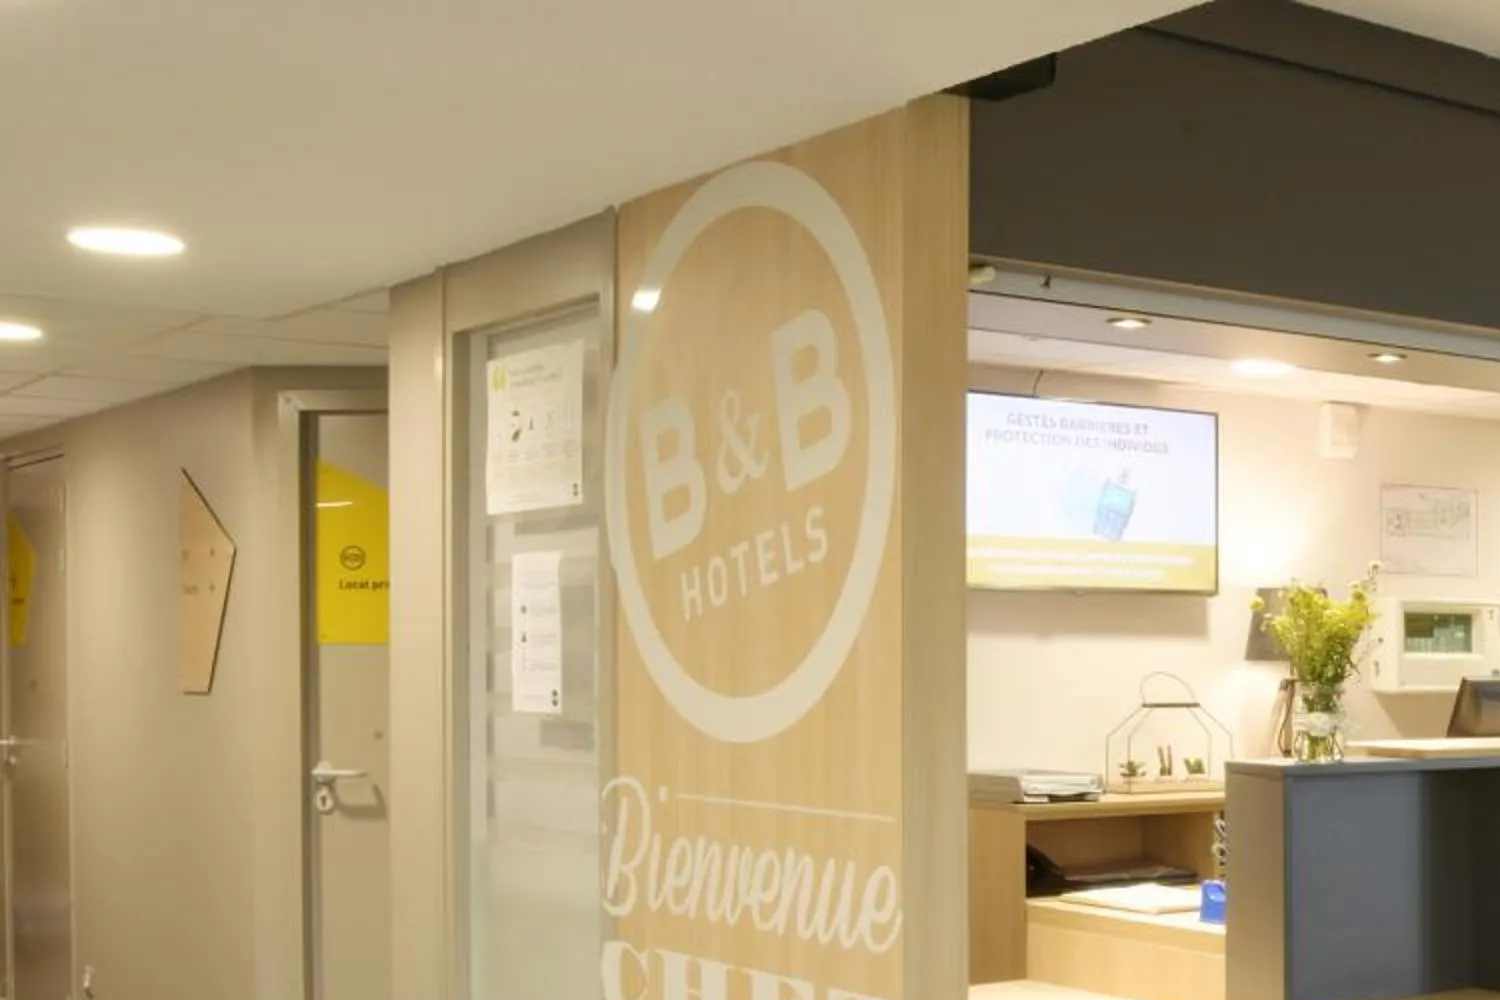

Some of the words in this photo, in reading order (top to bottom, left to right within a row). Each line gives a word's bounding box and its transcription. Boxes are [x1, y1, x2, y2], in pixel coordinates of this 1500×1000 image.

[639, 308, 852, 562] B&B
[1006, 412, 1057, 429] GESTES
[679, 506, 830, 623] HOTELS
[600, 775, 903, 954] Bienvenue
